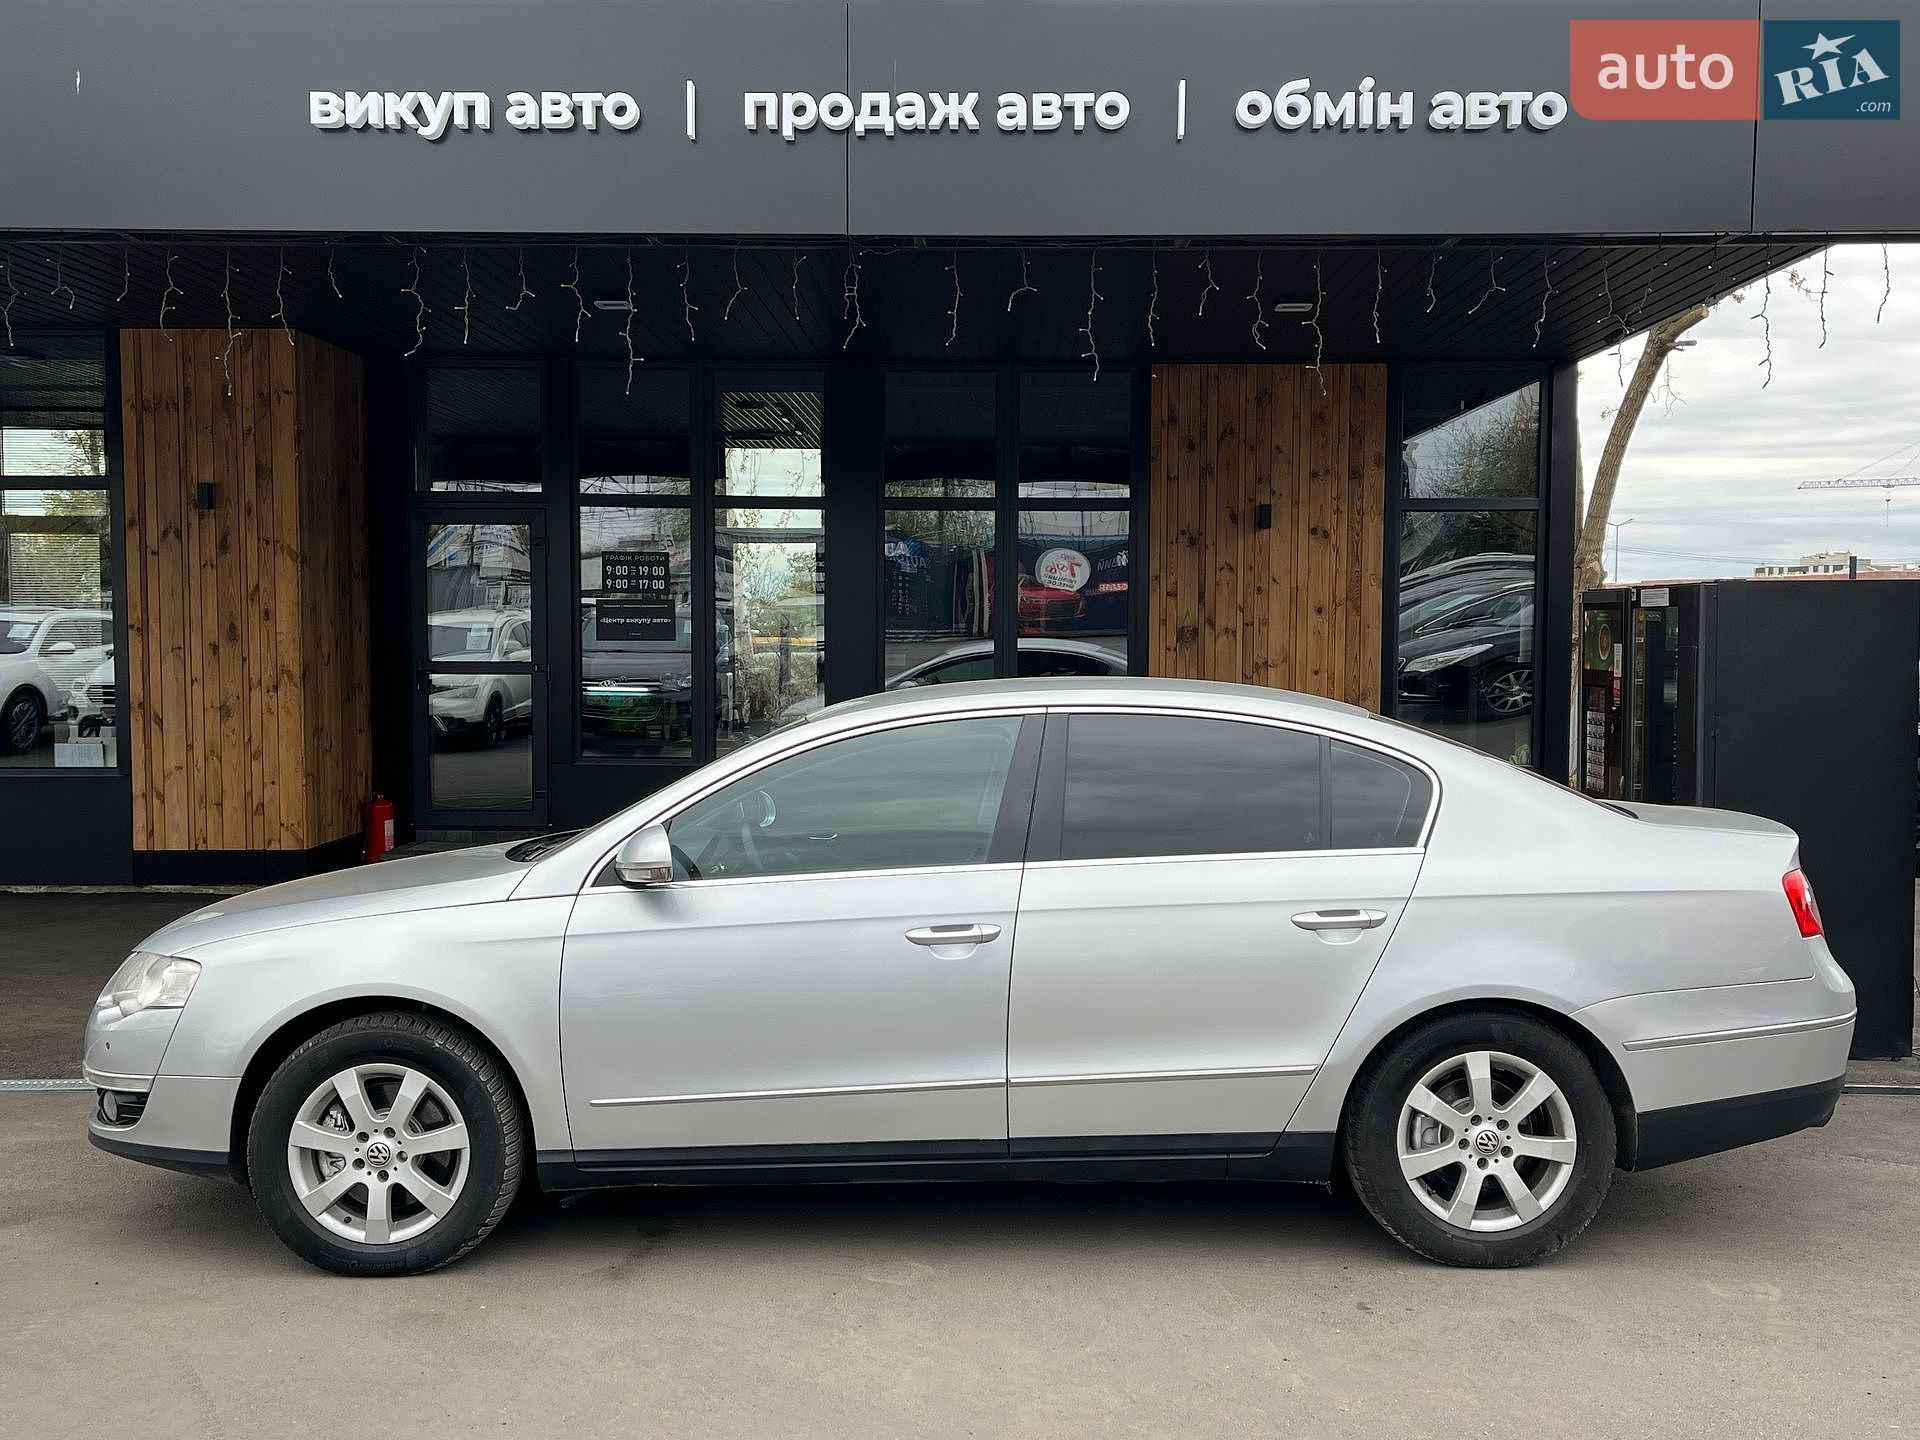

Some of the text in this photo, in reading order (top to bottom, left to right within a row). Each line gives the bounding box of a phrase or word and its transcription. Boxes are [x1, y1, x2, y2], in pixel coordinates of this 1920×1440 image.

[309, 77, 1569, 141] викуп авто продаж авто обмін авто
[606, 566, 628, 575] 9:00
[638, 566, 665, 576] 19:00
[606, 579, 628, 589] 9:00
[638, 580, 665, 590] 17:00
